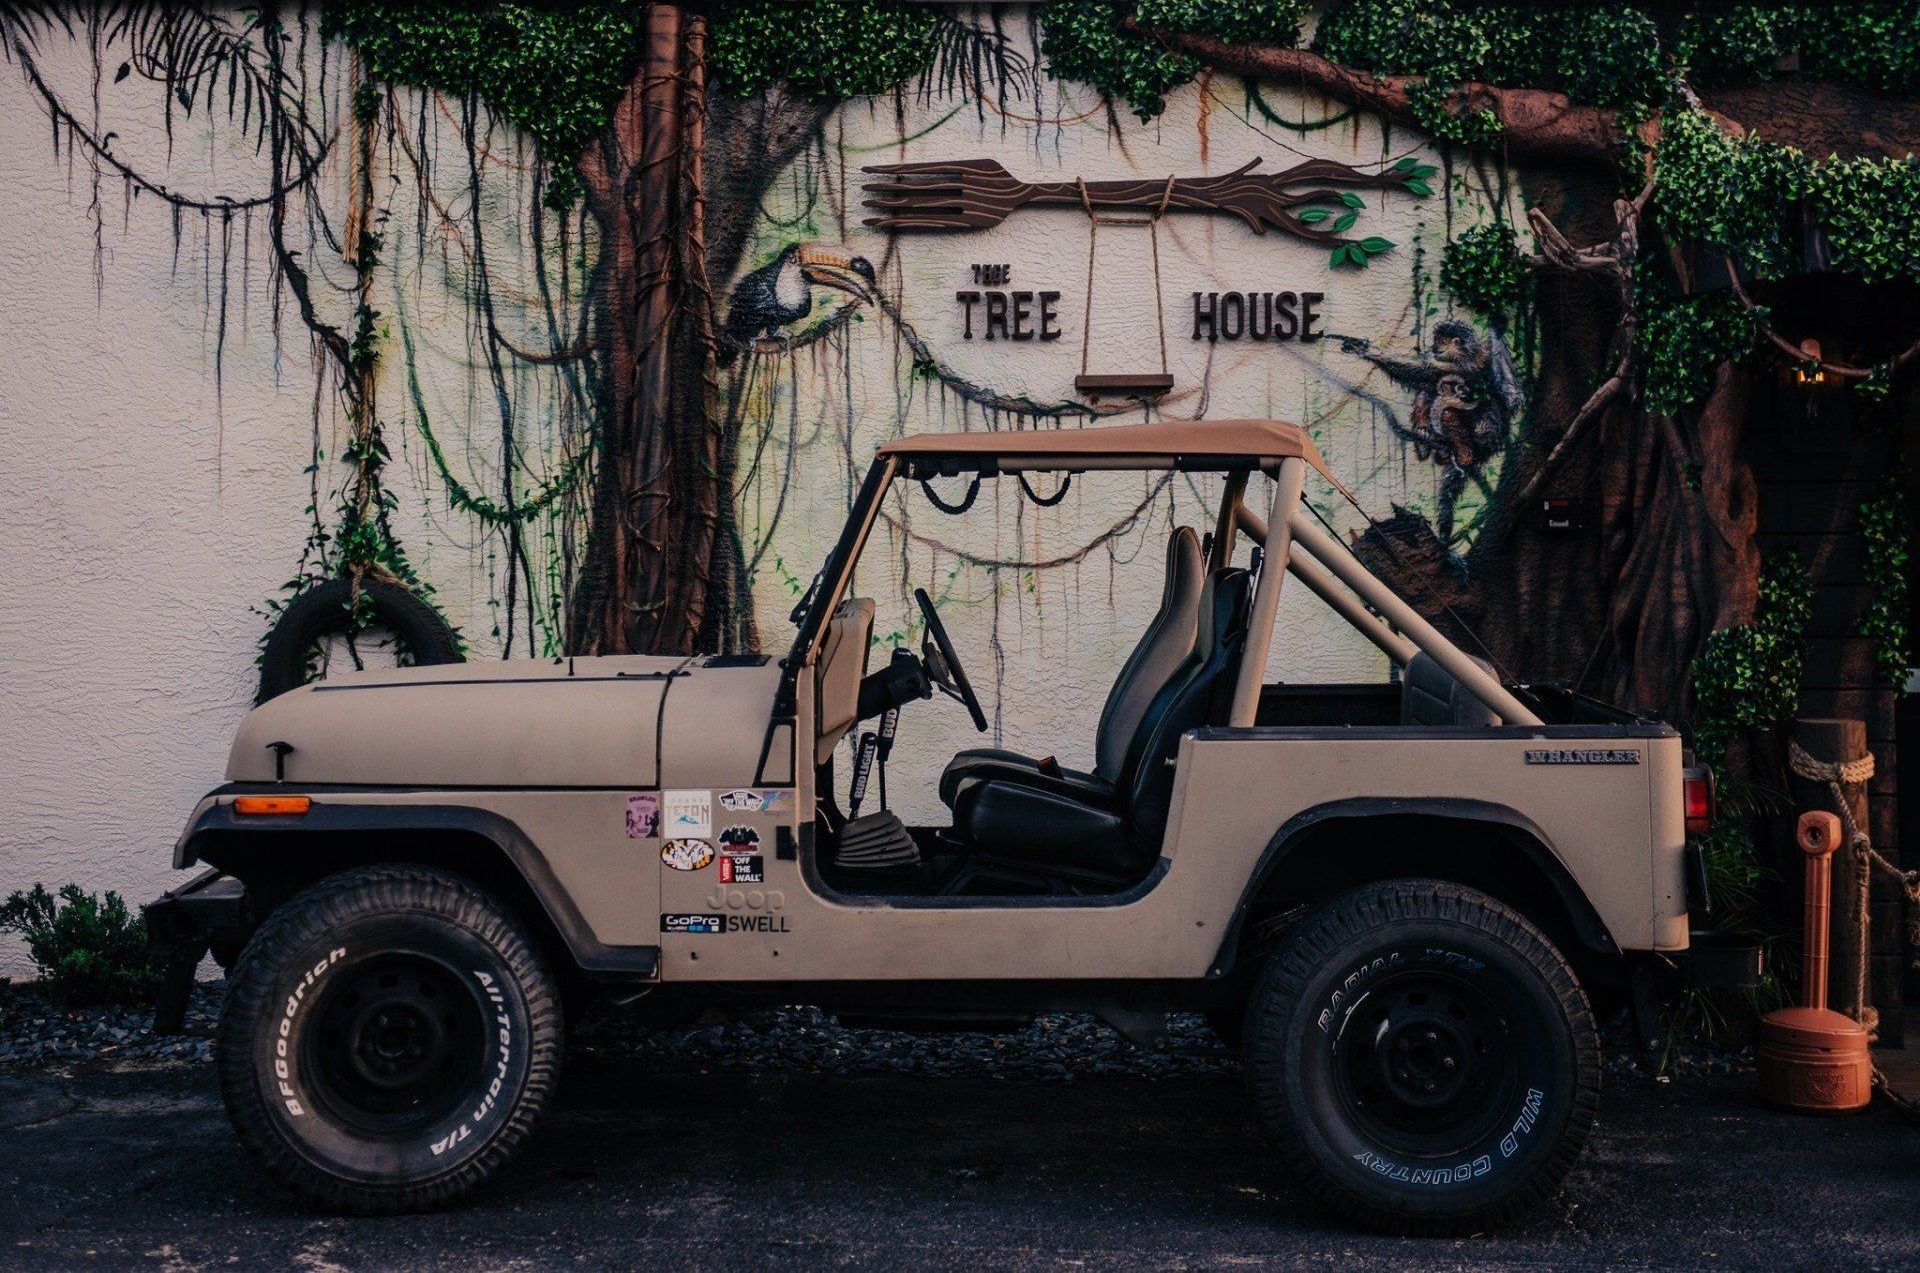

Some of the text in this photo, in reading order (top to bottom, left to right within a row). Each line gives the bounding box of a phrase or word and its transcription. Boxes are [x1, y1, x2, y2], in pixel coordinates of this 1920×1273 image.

[970, 263, 1011, 285] THE
[955, 290, 1325, 342] TREE HOUSE
[882, 708, 898, 739] BUD
[853, 743, 874, 799] BUD LIGHT
[1527, 749, 1640, 764] WRANGLER
[665, 804, 710, 825] TETON
[735, 865, 751, 873] THE
[666, 915, 720, 925] GoPro
[728, 915, 791, 933] SWELL
[1317, 948, 1487, 1034] RADIAL XTX
[274, 945, 347, 1116] BFGoodrich
[429, 970, 512, 1156] All-Terrain T/A
[1353, 1087, 1544, 1185] WILD COUNTRY
